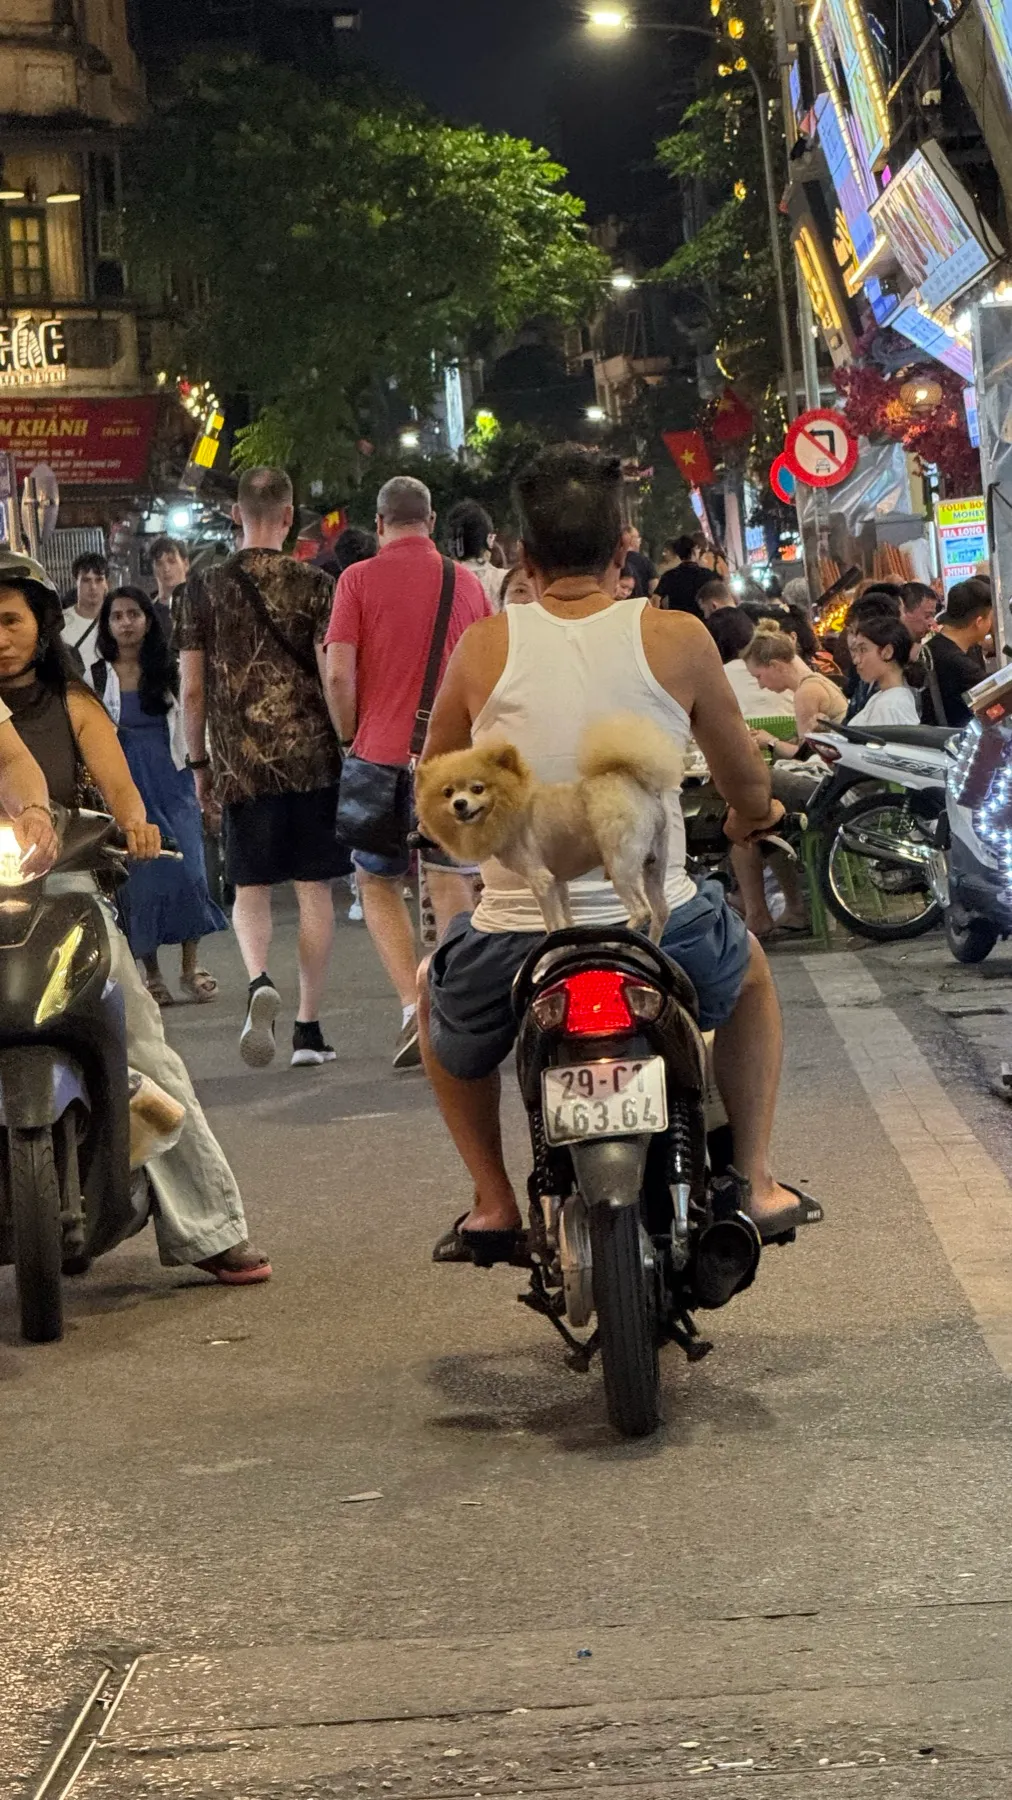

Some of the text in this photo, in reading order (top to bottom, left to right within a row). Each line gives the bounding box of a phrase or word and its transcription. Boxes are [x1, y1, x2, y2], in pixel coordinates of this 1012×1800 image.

[941, 500, 984, 512] TOUR BO
[953, 510, 985, 519] MONEY
[943, 526, 983, 538] HA LONG
